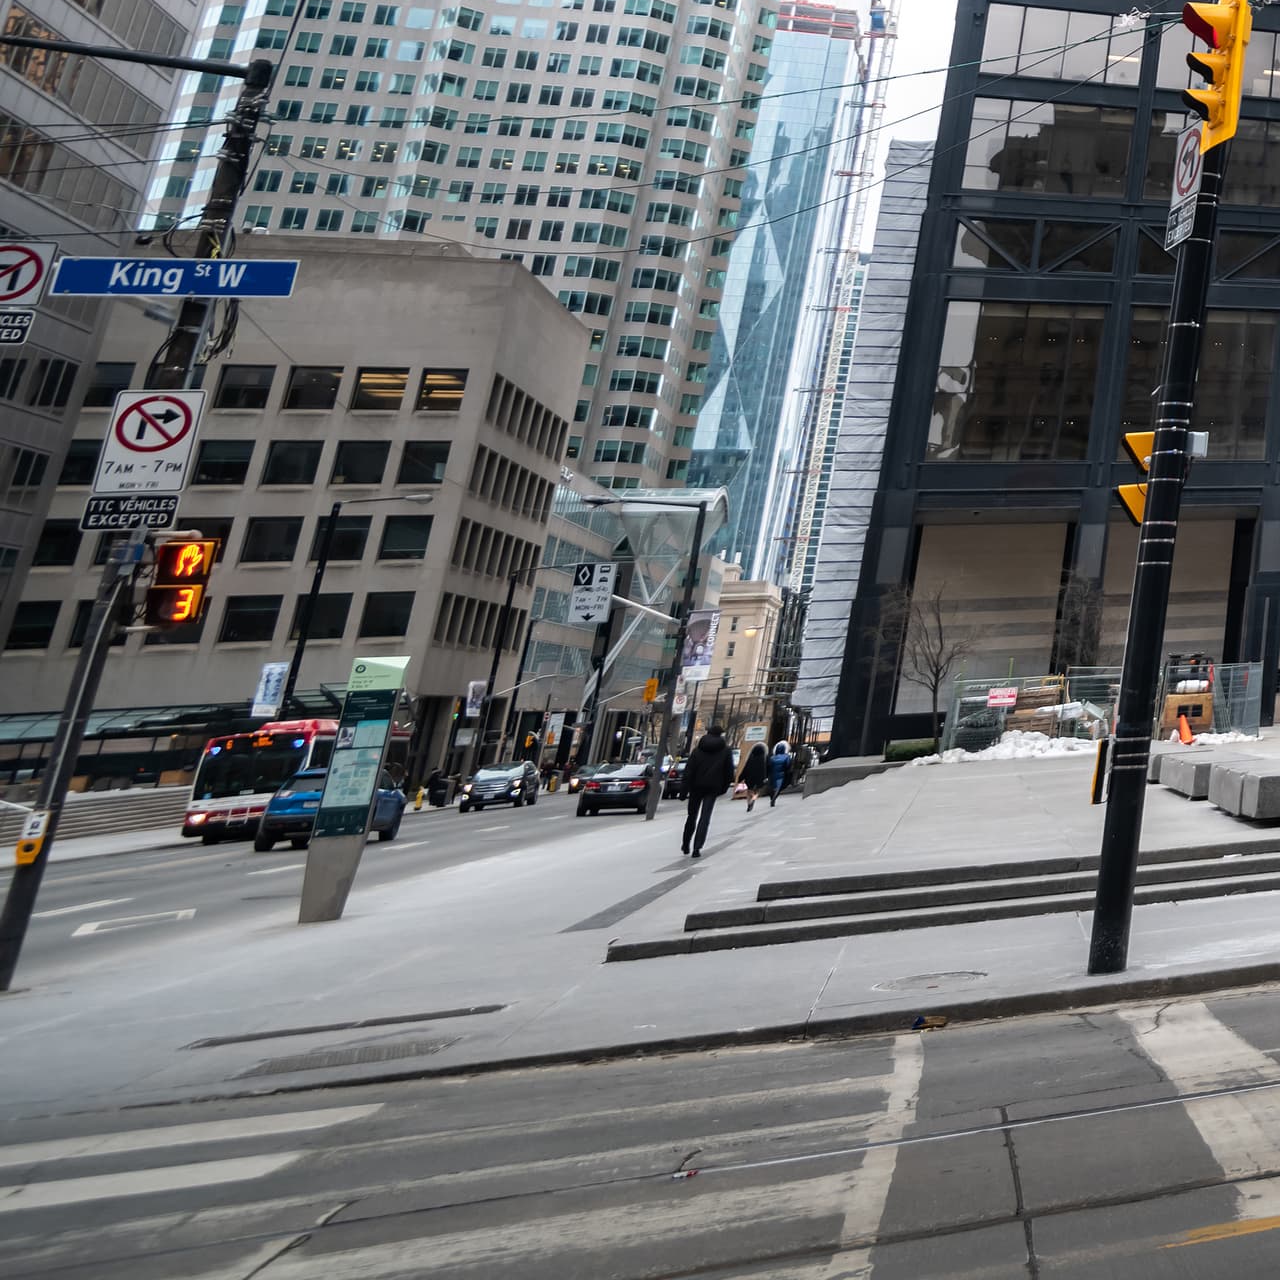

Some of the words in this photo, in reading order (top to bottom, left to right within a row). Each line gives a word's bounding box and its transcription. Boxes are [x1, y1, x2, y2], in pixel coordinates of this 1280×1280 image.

[108, 261, 184, 293] King
[194, 263, 213, 278] St
[218, 264, 247, 288] W
[0, 328, 22, 339] ED
[89, 500, 114, 512] TTC
[120, 499, 176, 511] VEHICLES
[88, 513, 168, 526] EXCEPTED
[172, 588, 194, 621] 3
[706, 612, 721, 647] CONNECT
